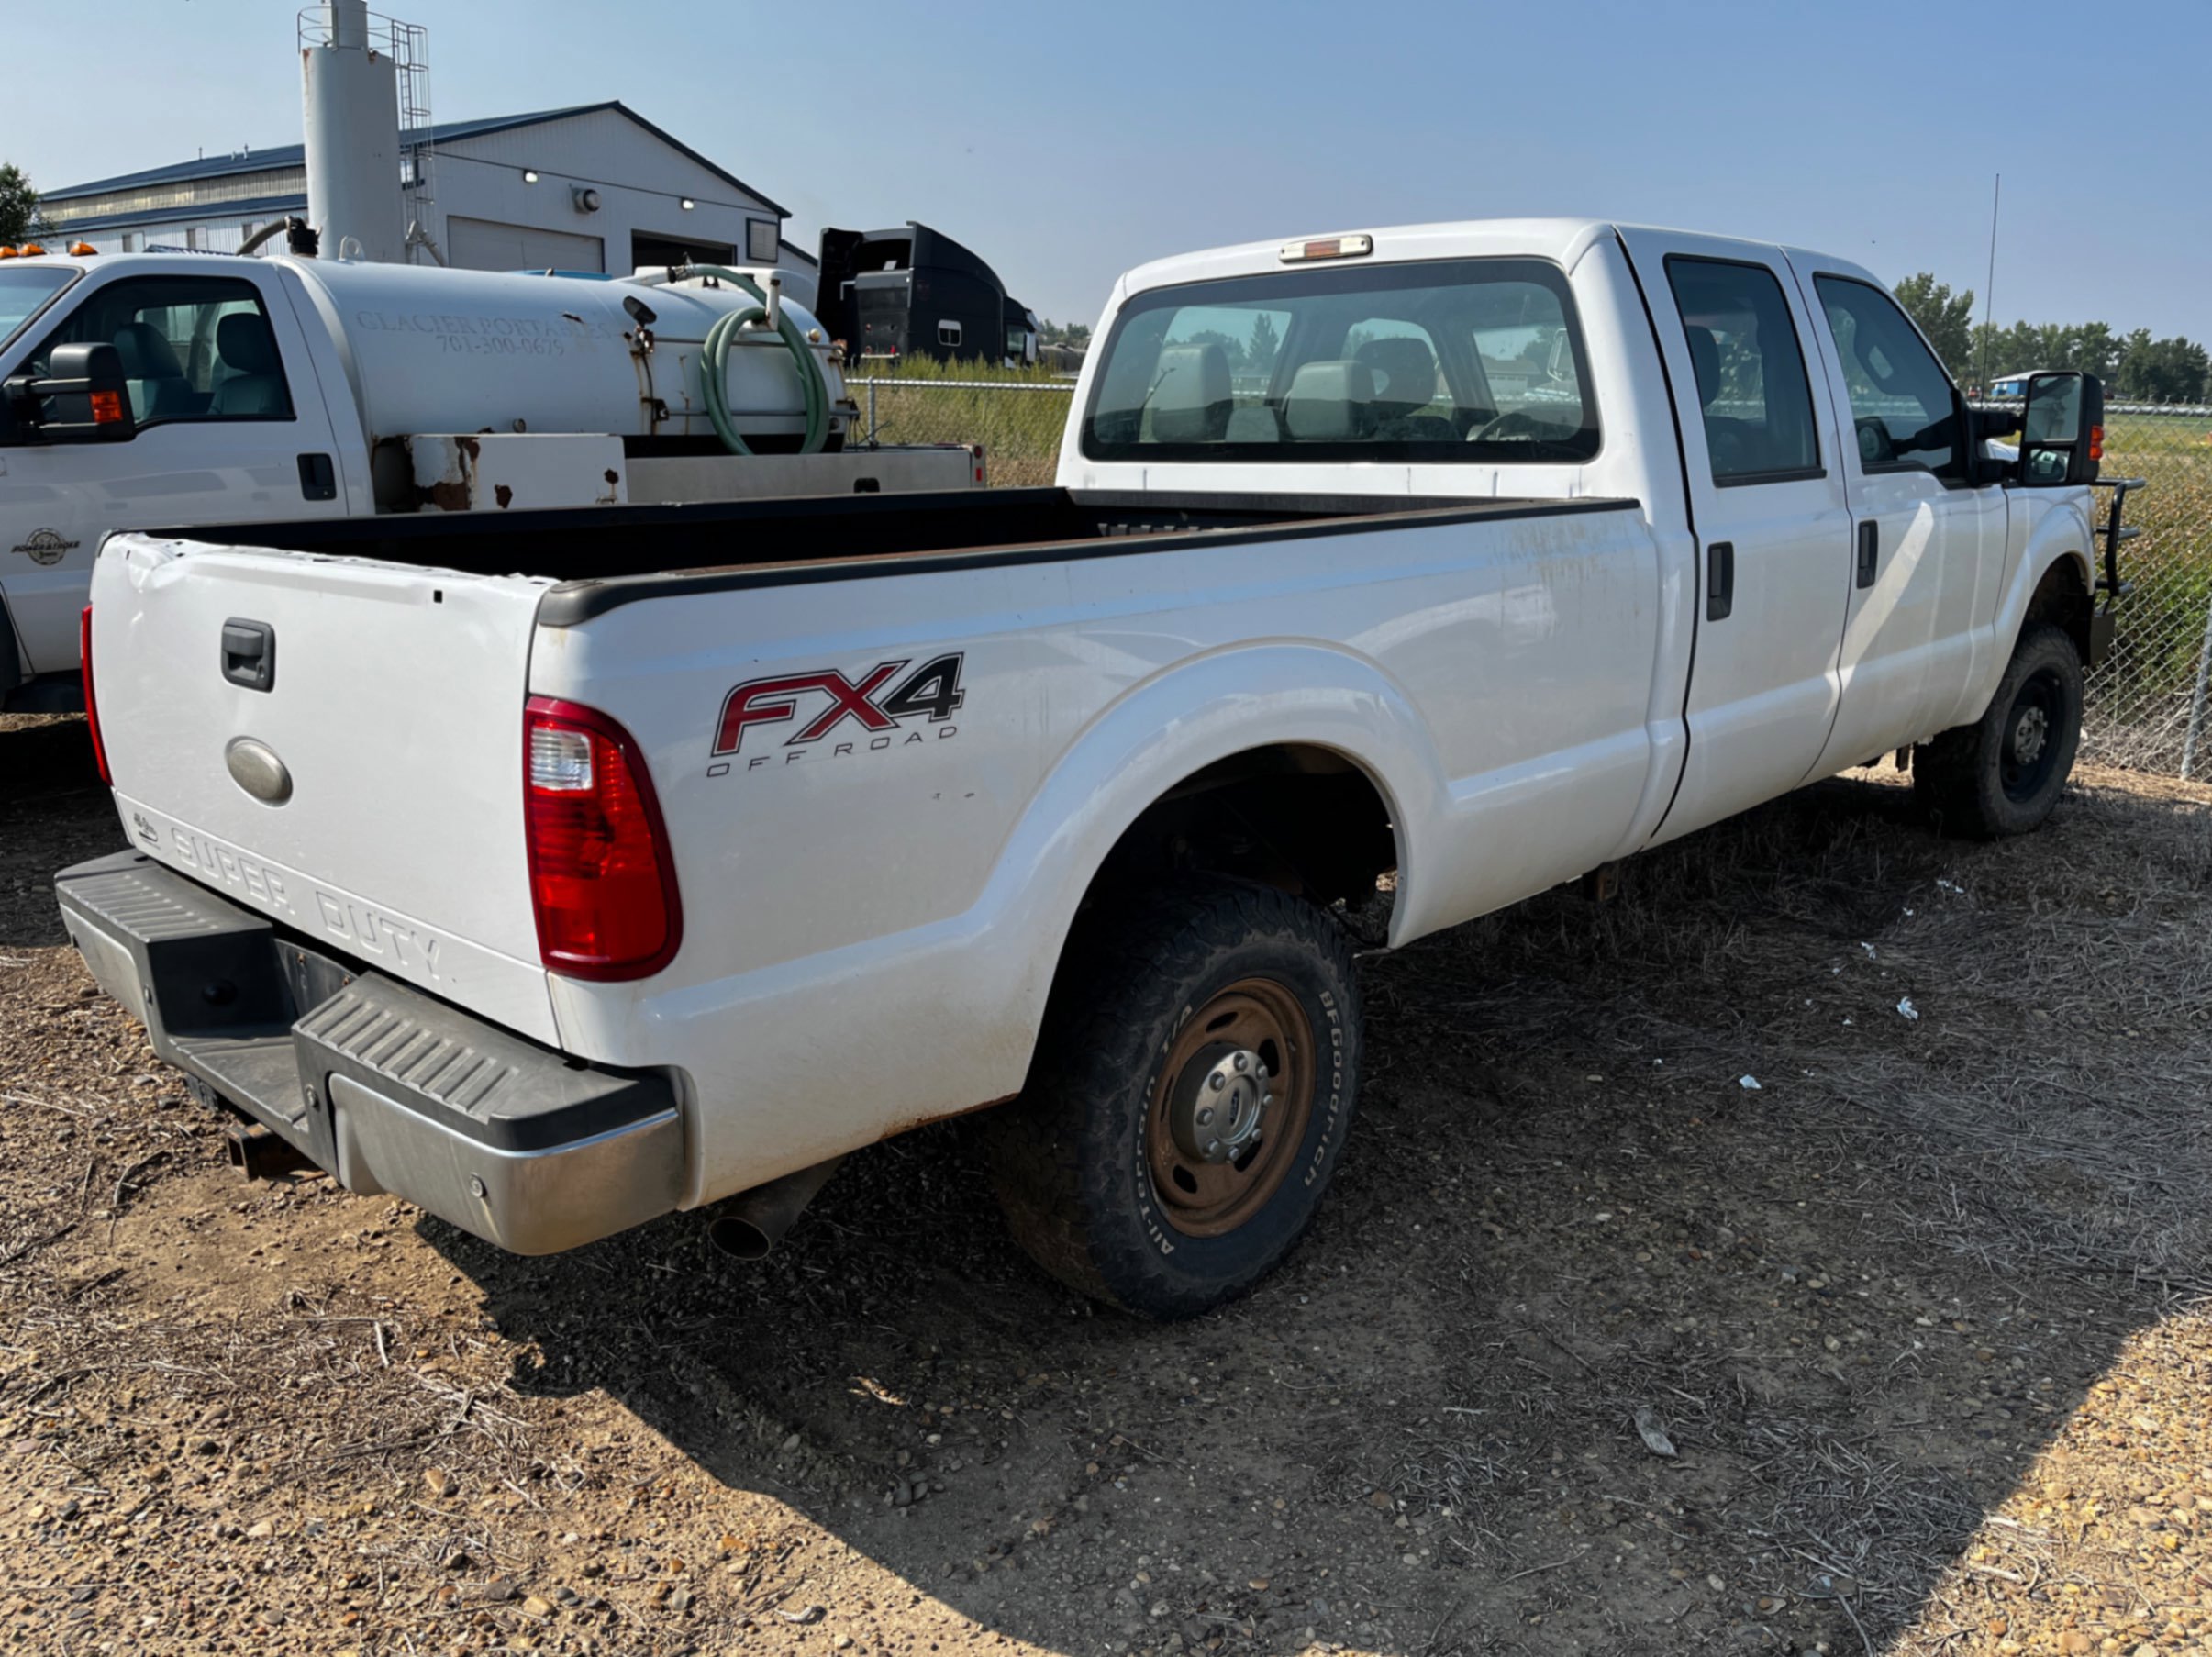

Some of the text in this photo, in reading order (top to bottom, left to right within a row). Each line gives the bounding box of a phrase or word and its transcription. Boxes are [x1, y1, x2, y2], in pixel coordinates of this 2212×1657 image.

[355, 311, 610, 339] GLACIER PORTABES
[710, 651, 965, 758] FX4
[706, 726, 957, 778] OFF ROAD
[171, 826, 297, 917] SUPER
[317, 890, 441, 980] DUTY
